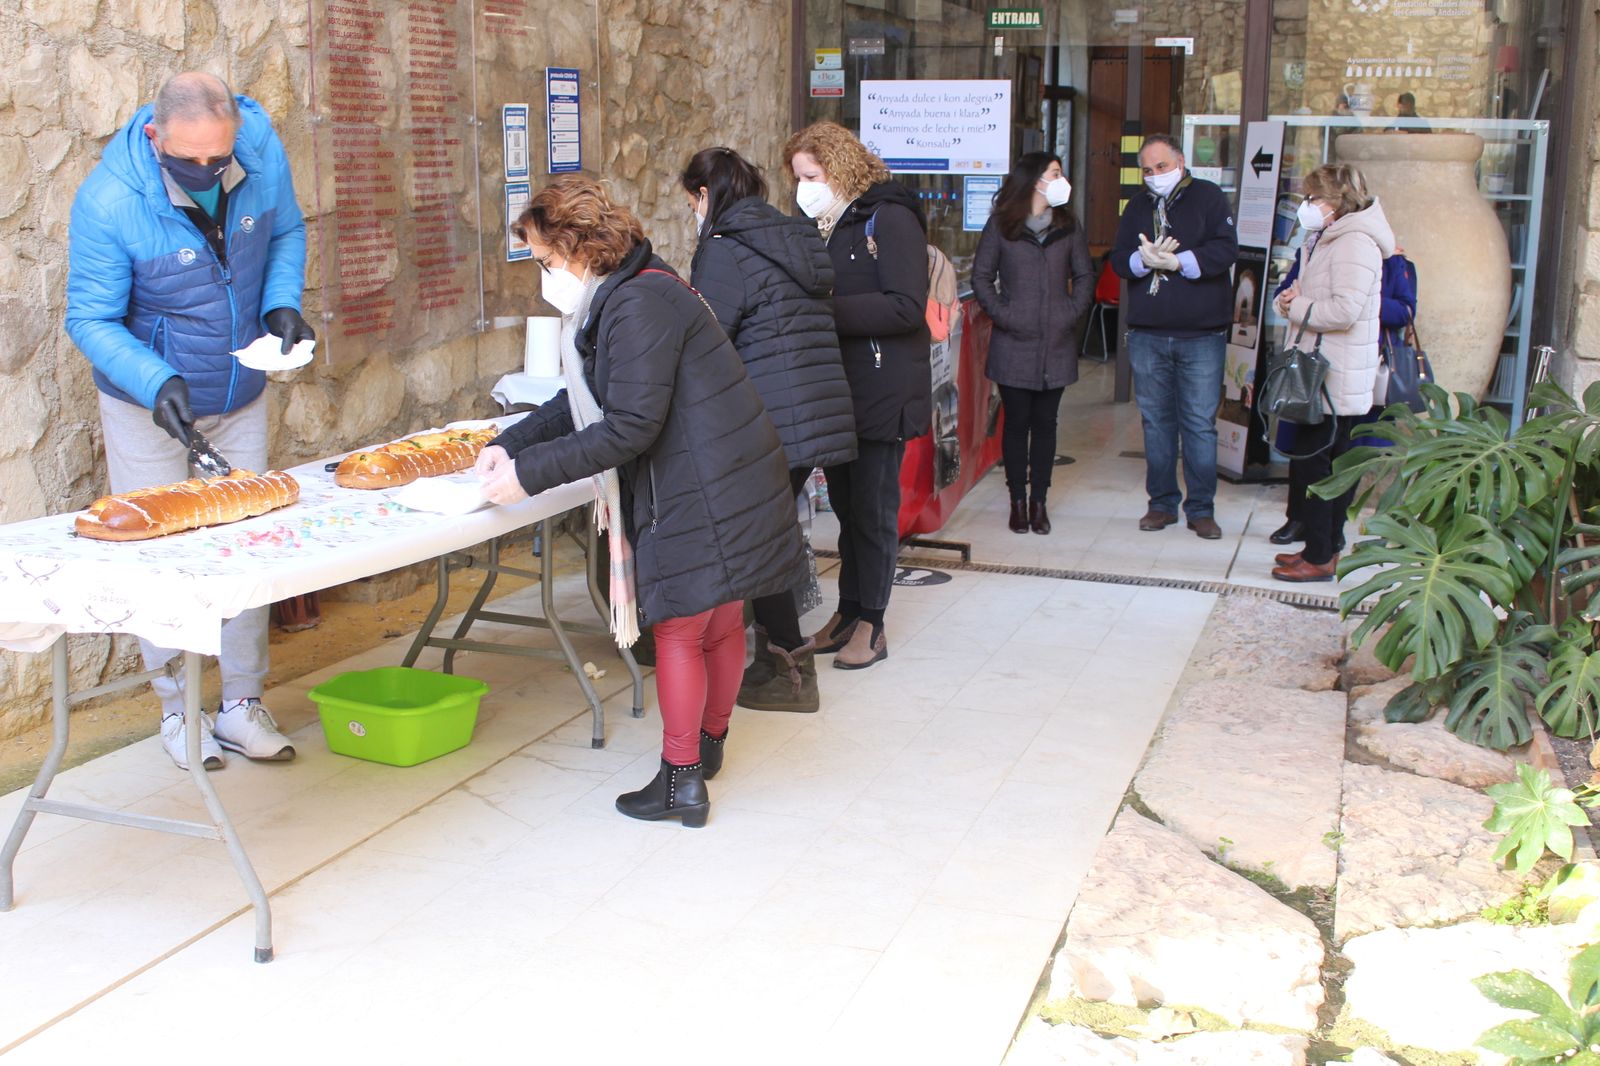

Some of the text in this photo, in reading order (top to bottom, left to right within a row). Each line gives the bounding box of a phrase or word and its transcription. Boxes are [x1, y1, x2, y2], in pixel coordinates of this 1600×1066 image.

[992, 12, 1040, 24] ENTRADA
[912, 93, 936, 103] dulce
[944, 93, 961, 103] kon
[924, 108, 950, 118] buena
[922, 123, 933, 133] de
[935, 123, 958, 133] leche
